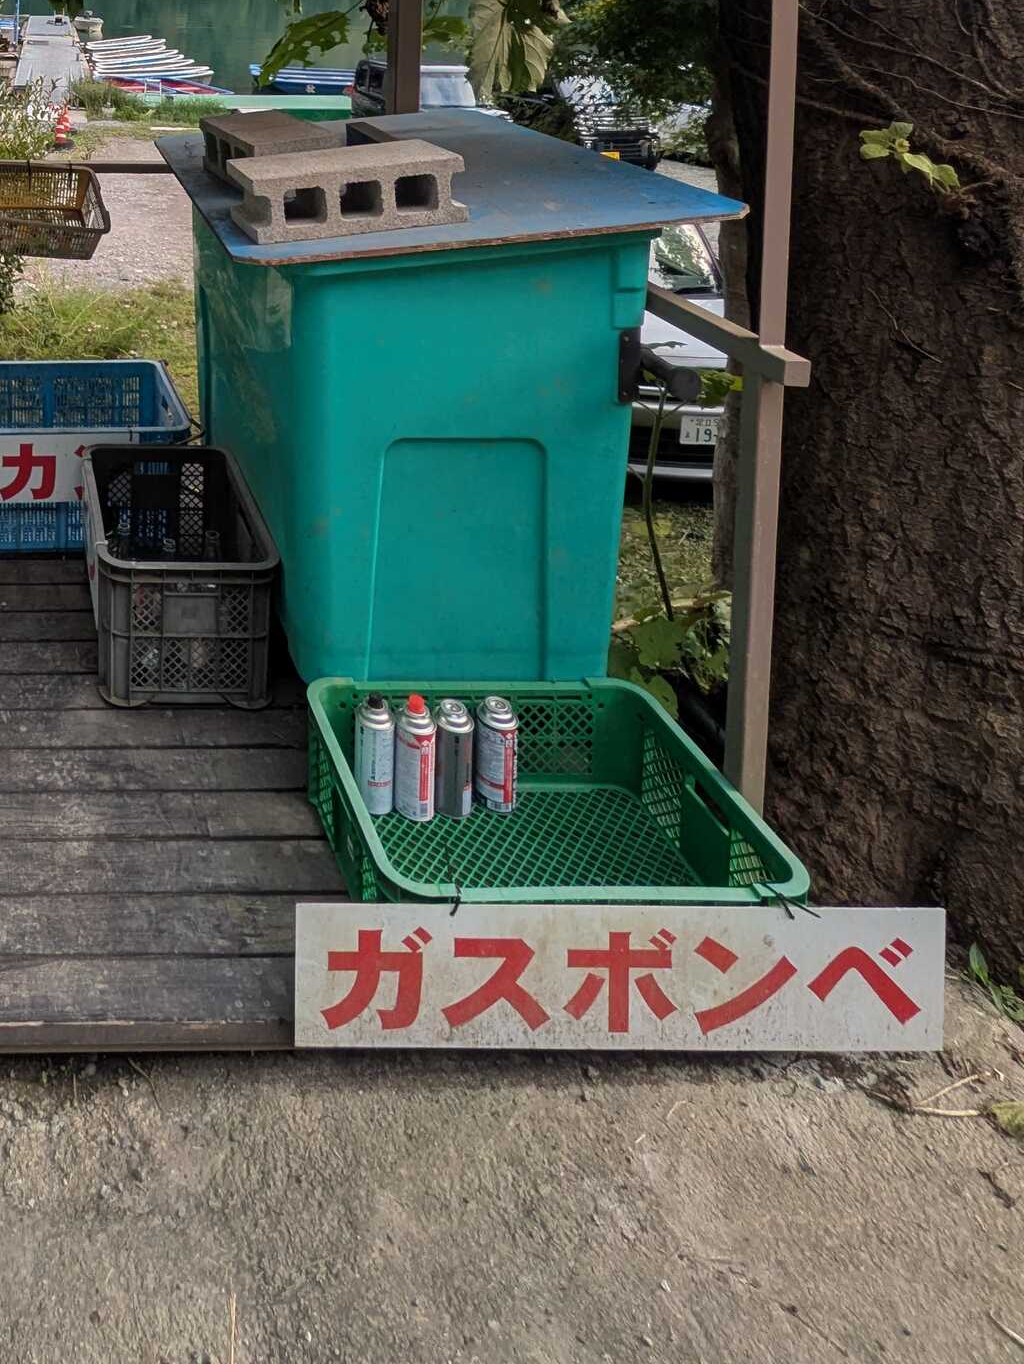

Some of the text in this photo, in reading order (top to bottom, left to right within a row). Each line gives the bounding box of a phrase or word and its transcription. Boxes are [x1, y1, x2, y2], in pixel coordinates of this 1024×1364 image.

[320, 926, 922, 1035] ガスボンベ
